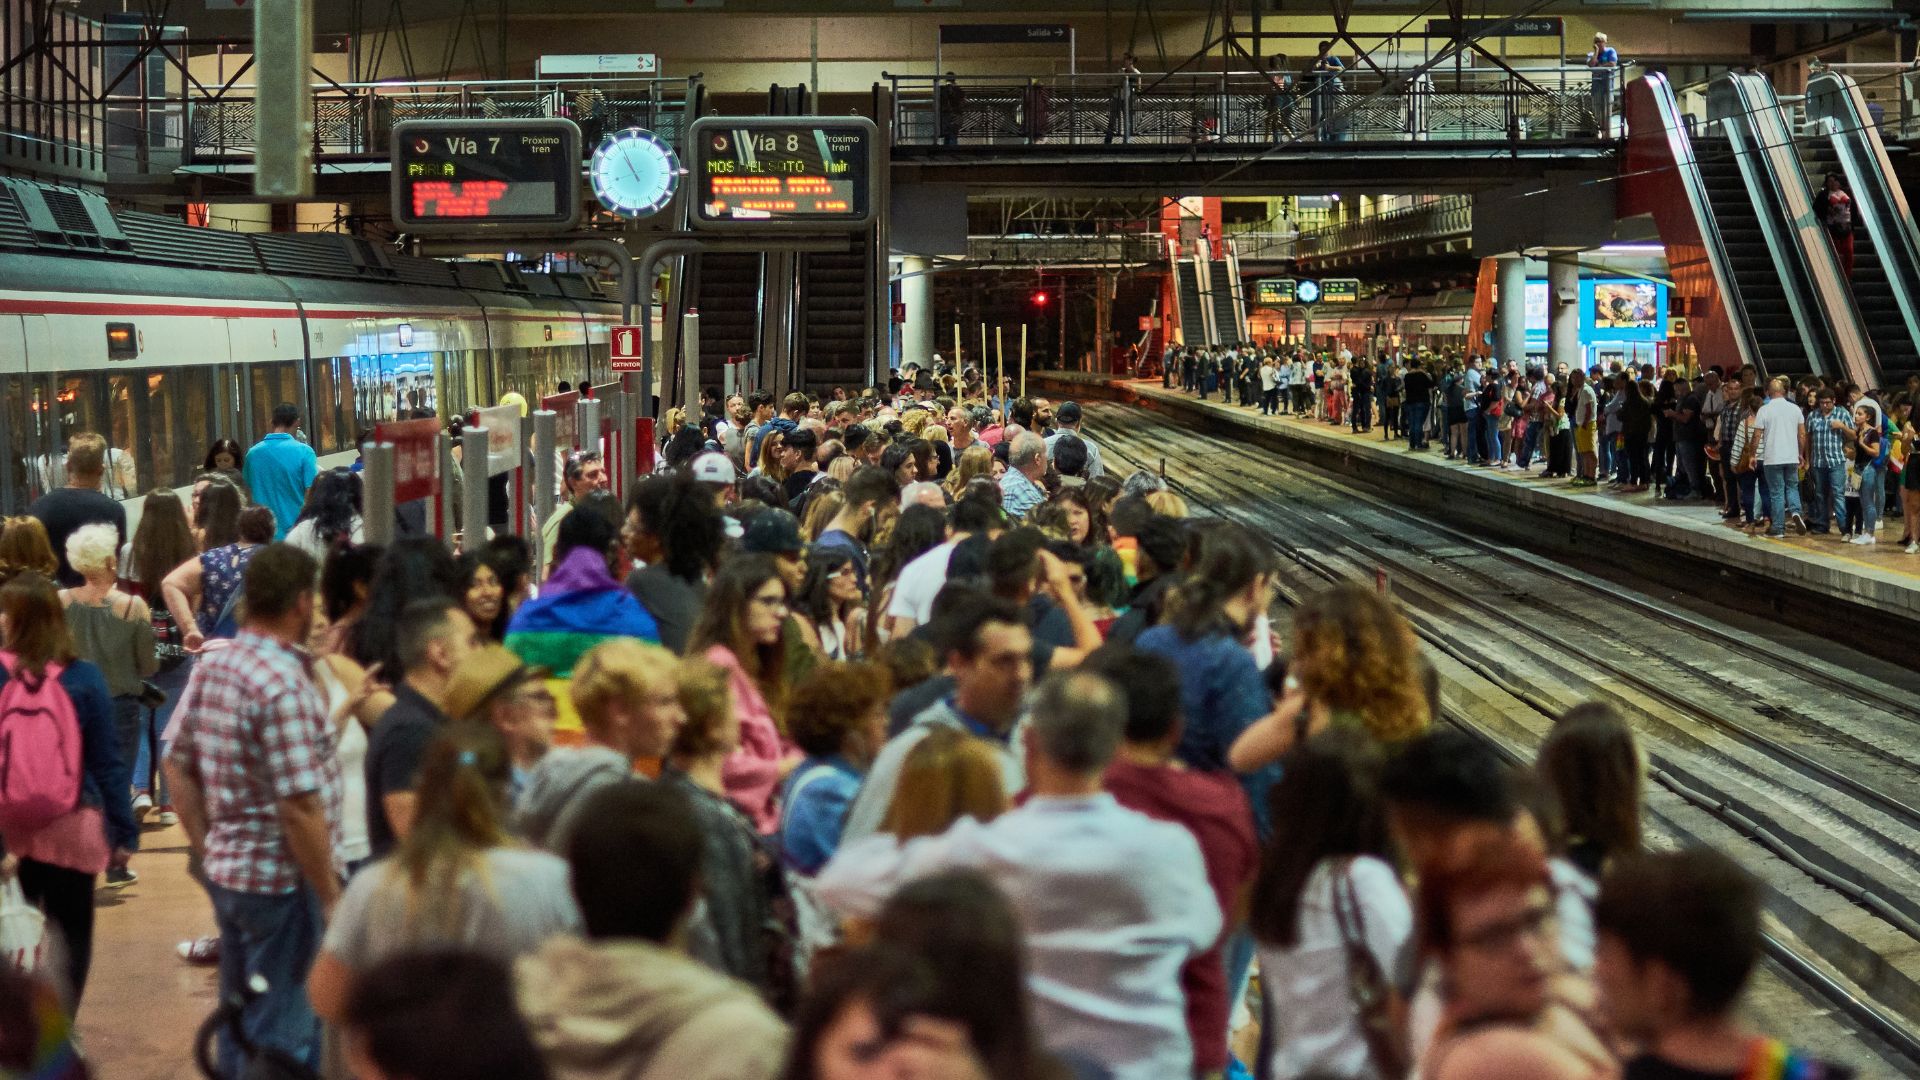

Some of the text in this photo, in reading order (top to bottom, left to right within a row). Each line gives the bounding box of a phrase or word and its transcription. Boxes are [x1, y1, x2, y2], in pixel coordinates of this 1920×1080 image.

[1514, 22, 1539, 31] Salida
[1027, 28, 1051, 37] Salida
[522, 136, 560, 145] Próximo
[786, 134, 799, 152] 8
[446, 137, 501, 155] Vía 7
[531, 144, 551, 153] tren
[831, 143, 851, 152] tren
